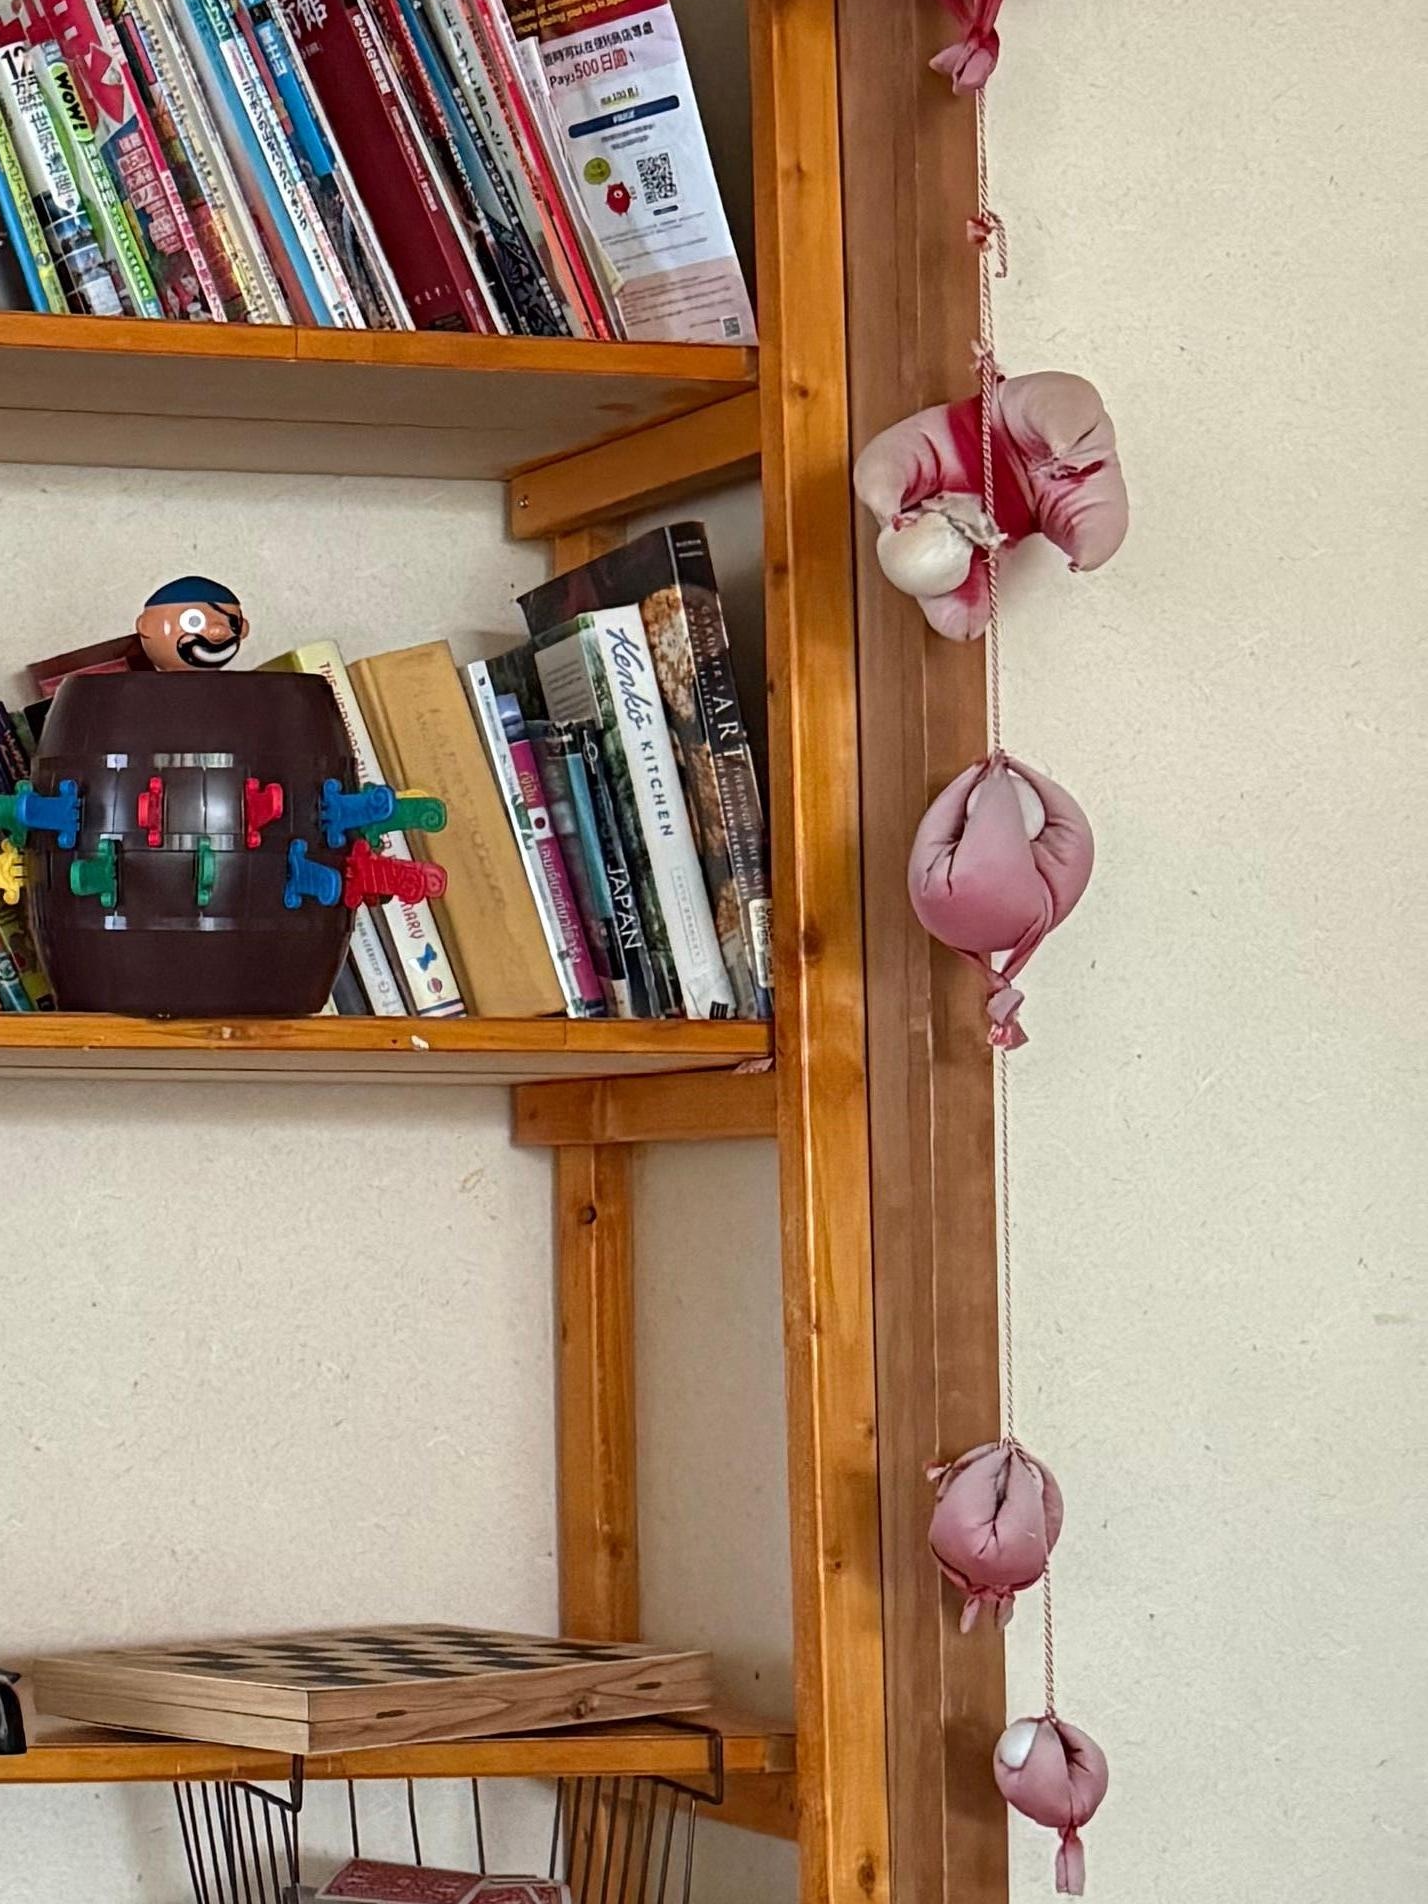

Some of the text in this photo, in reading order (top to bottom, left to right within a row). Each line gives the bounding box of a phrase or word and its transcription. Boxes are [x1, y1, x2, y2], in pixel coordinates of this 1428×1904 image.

[55, 70, 89, 137] WOW!
[639, 739, 675, 839] KITCHEN
[711, 694, 746, 762] ART
[733, 765, 756, 830] THROUGH
[605, 864, 642, 951] JAPAN
